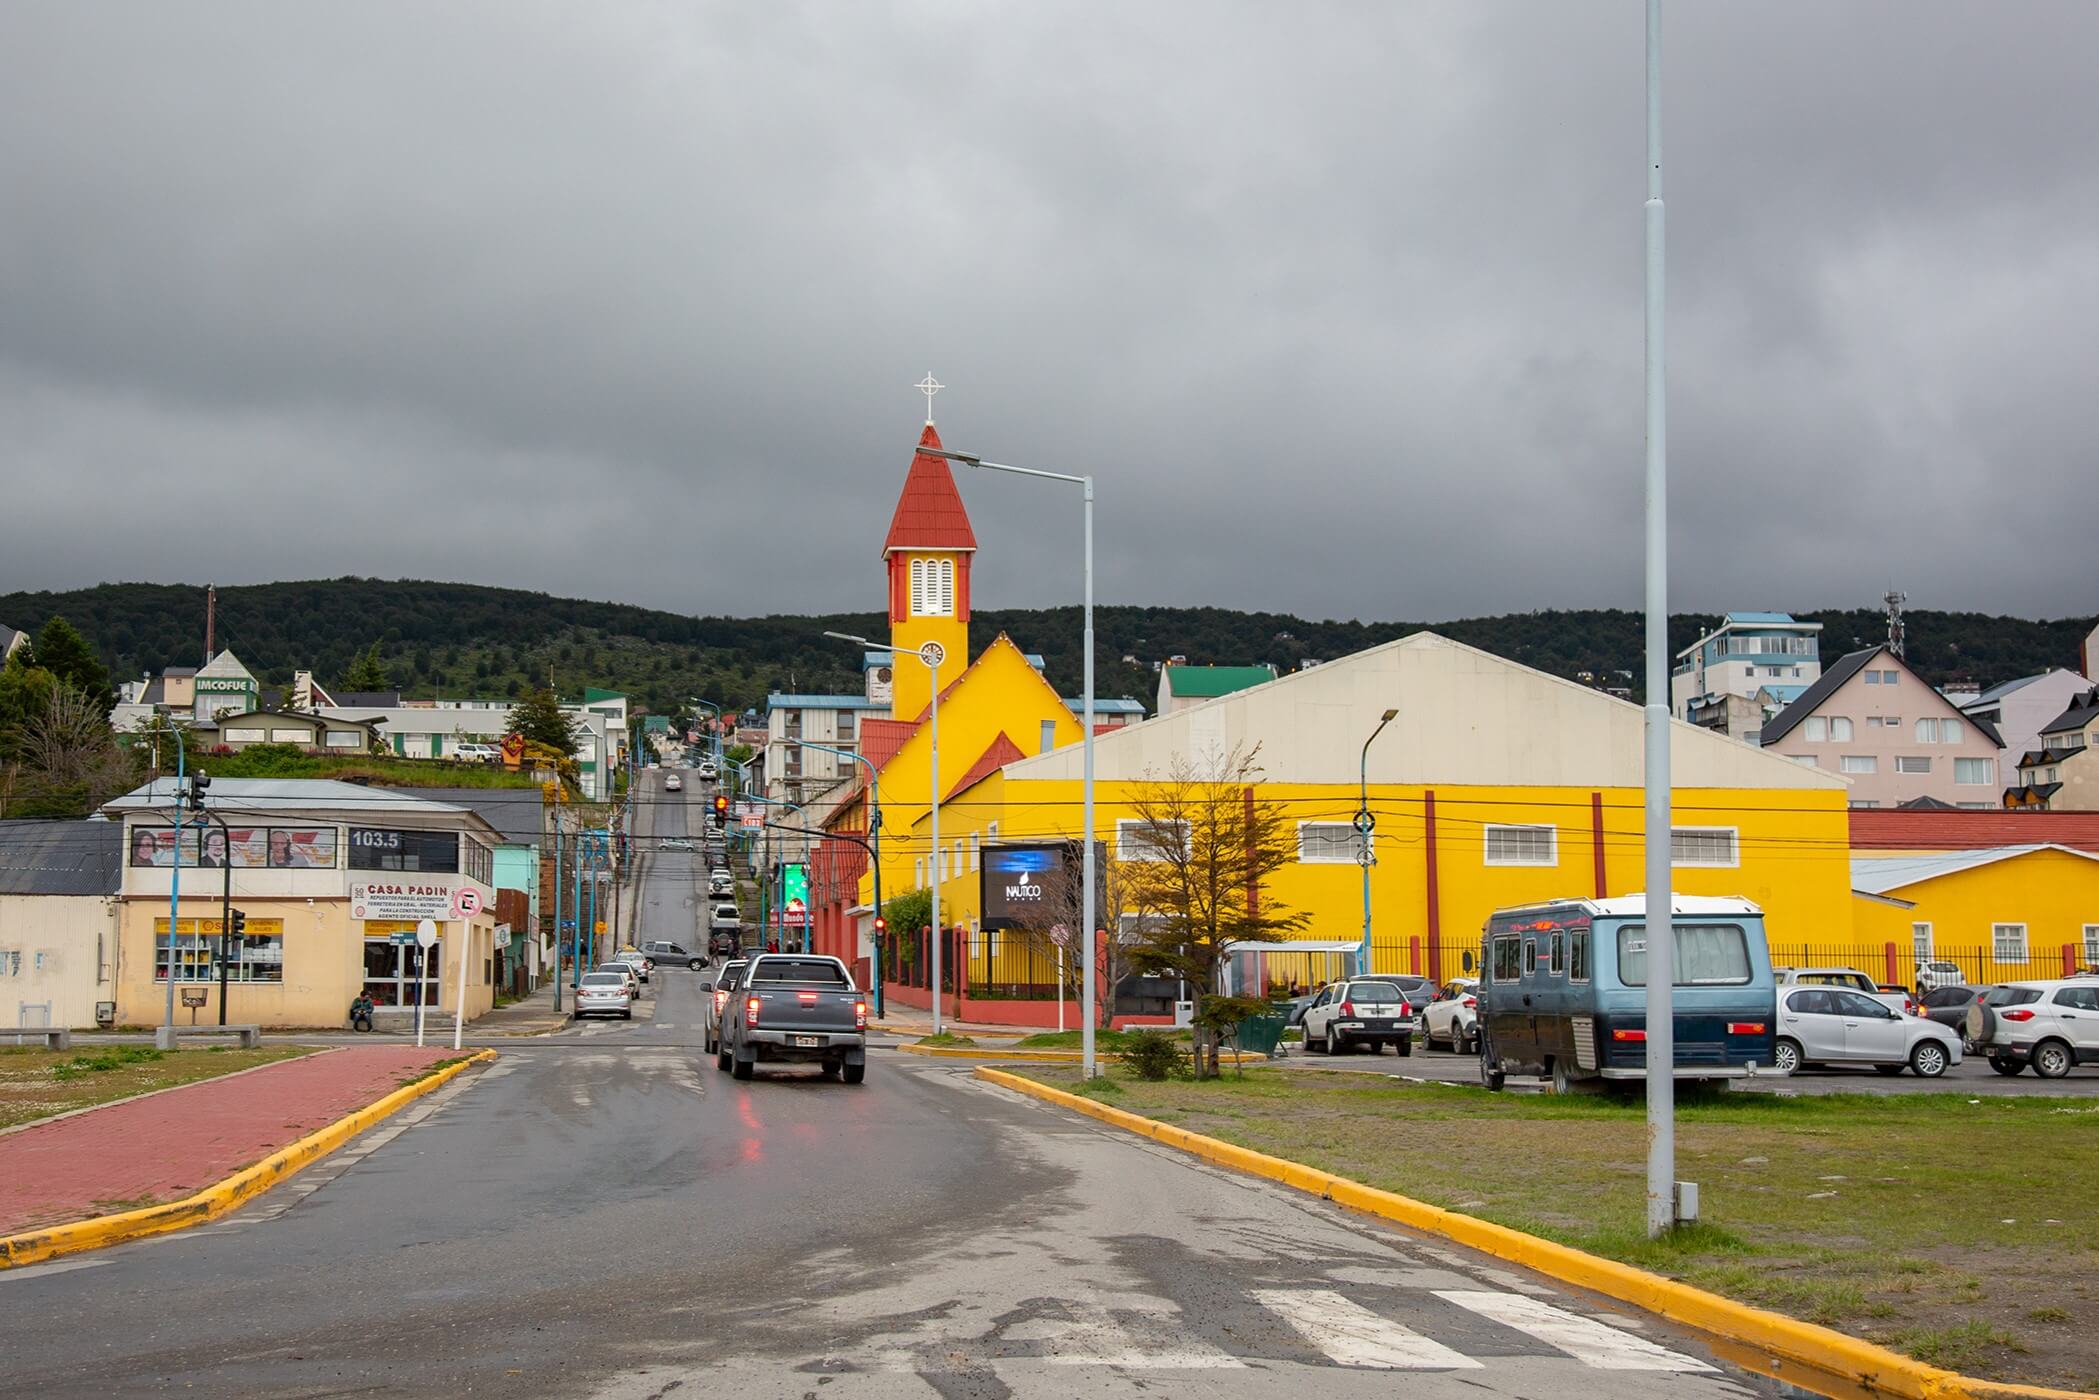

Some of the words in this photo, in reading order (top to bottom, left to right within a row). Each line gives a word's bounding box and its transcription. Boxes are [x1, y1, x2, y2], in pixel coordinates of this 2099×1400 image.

[196, 680, 247, 691] IMCOFUE
[353, 831, 398, 848] 103.5
[367, 885, 402, 894] CASA
[408, 886, 447, 896] PADIN
